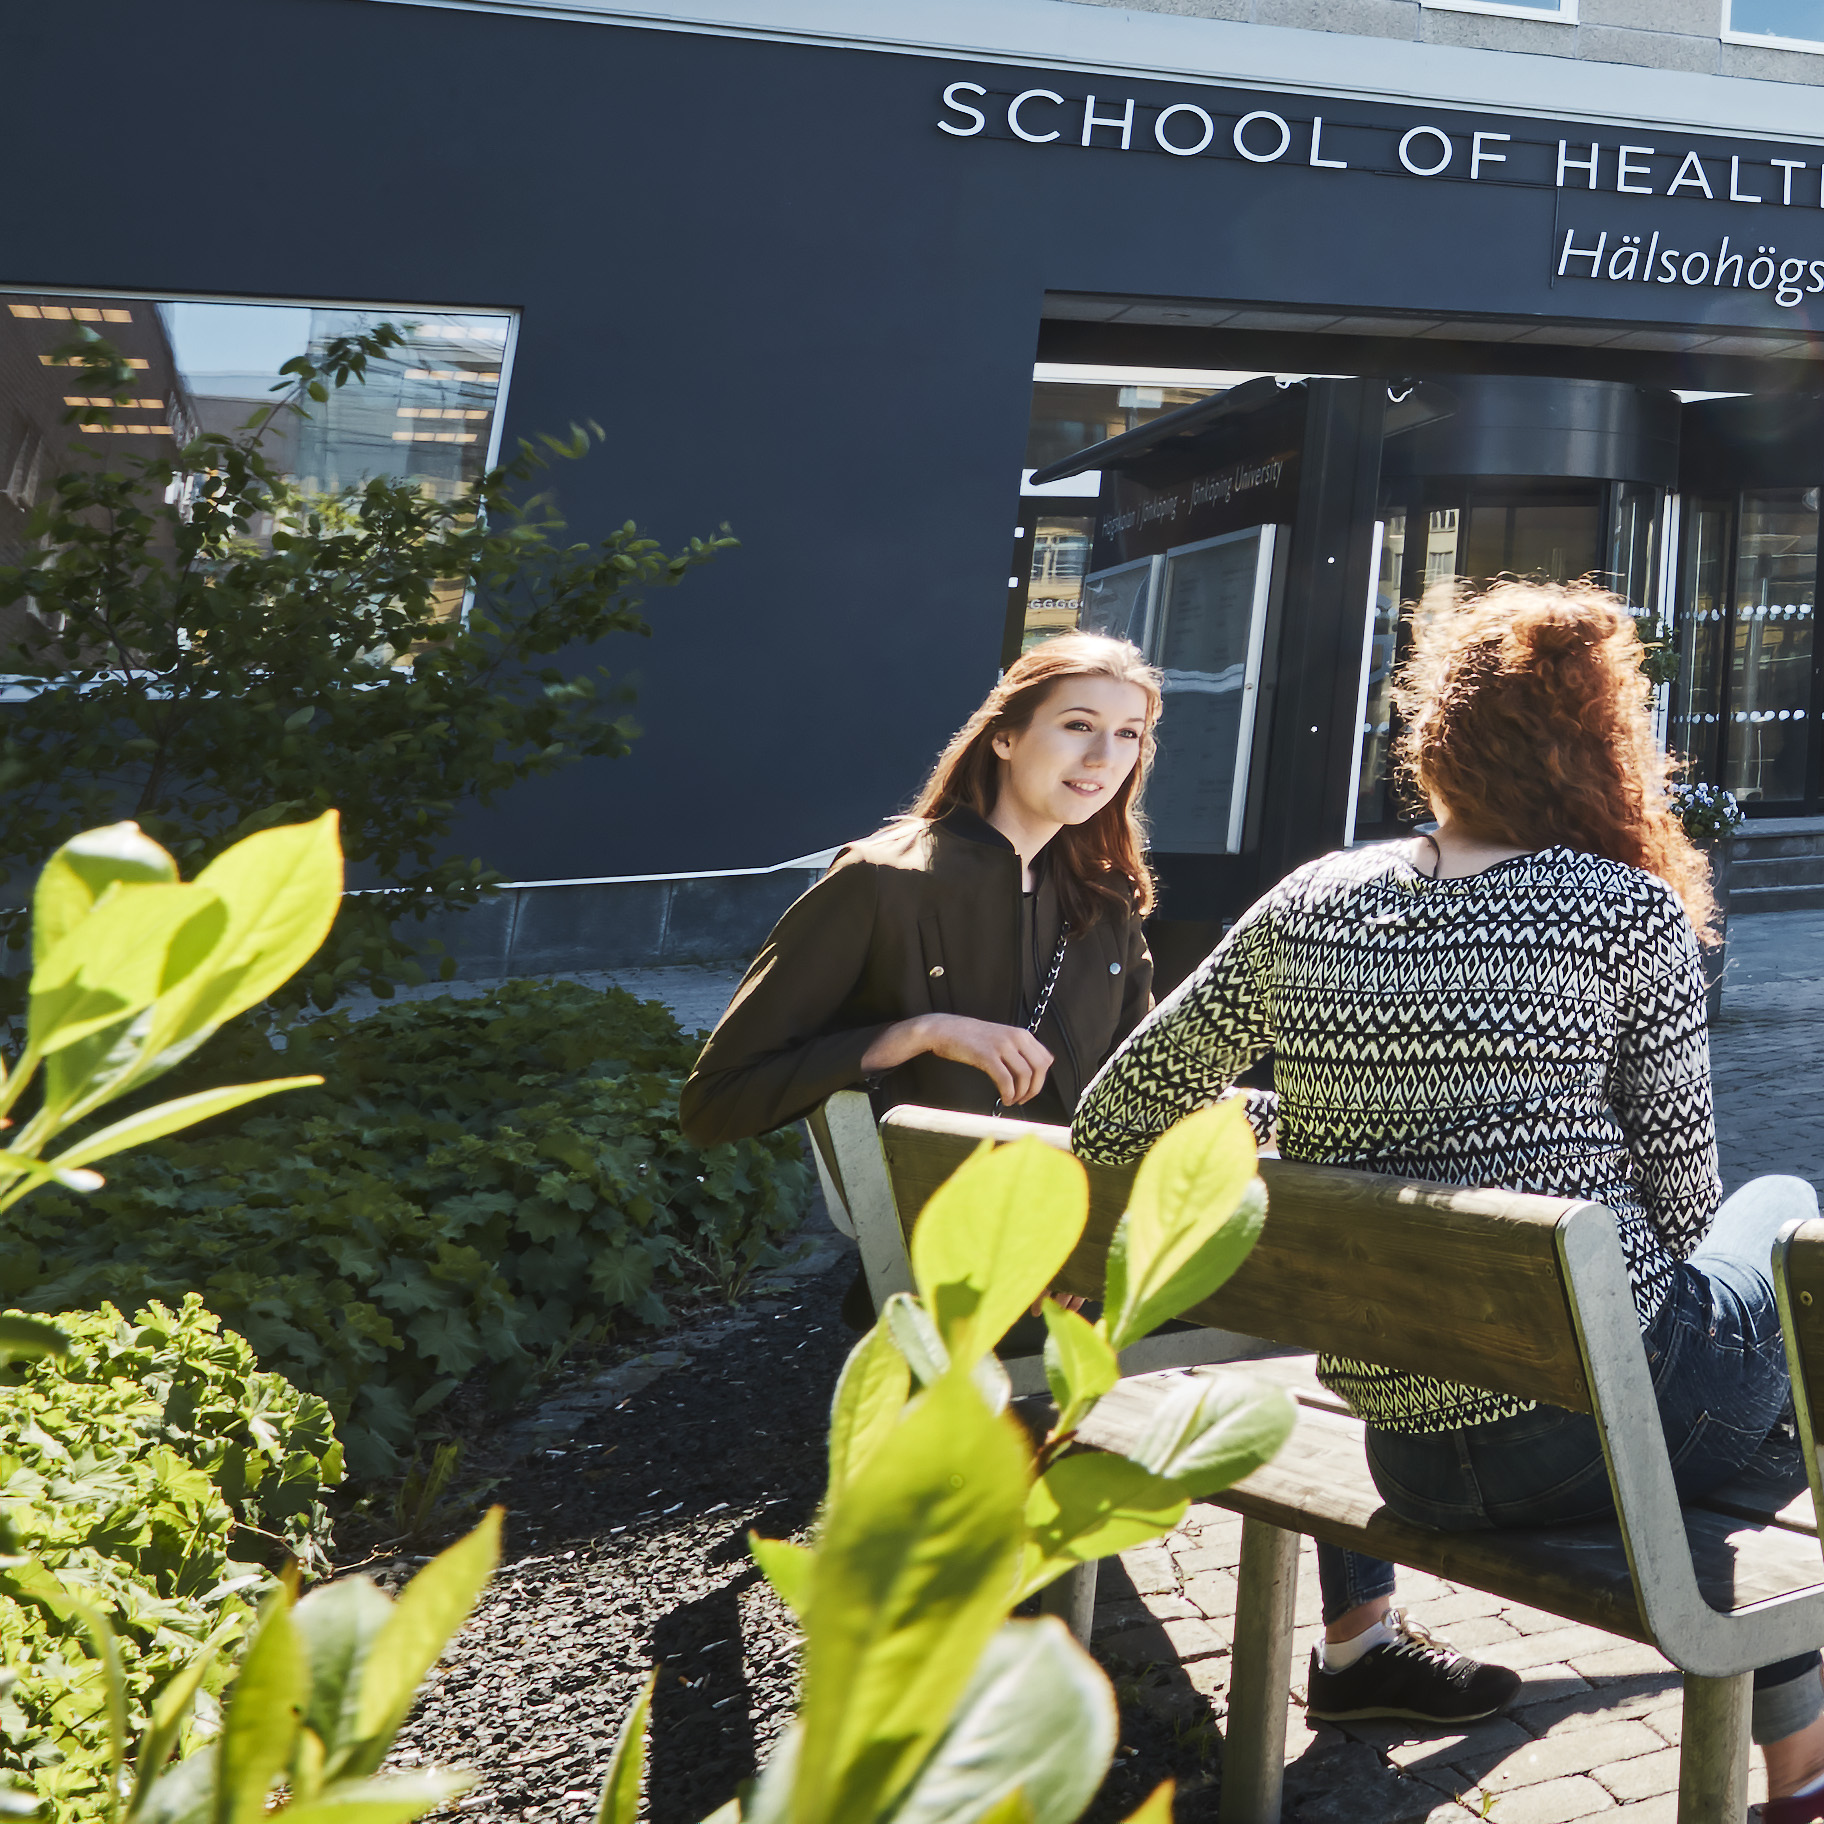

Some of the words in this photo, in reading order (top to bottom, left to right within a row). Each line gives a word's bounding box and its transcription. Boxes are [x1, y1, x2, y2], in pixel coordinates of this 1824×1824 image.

[937, 81, 1348, 170] SCHOOL
[1399, 124, 1511, 180] OF
[1234, 459, 1283, 493] University
